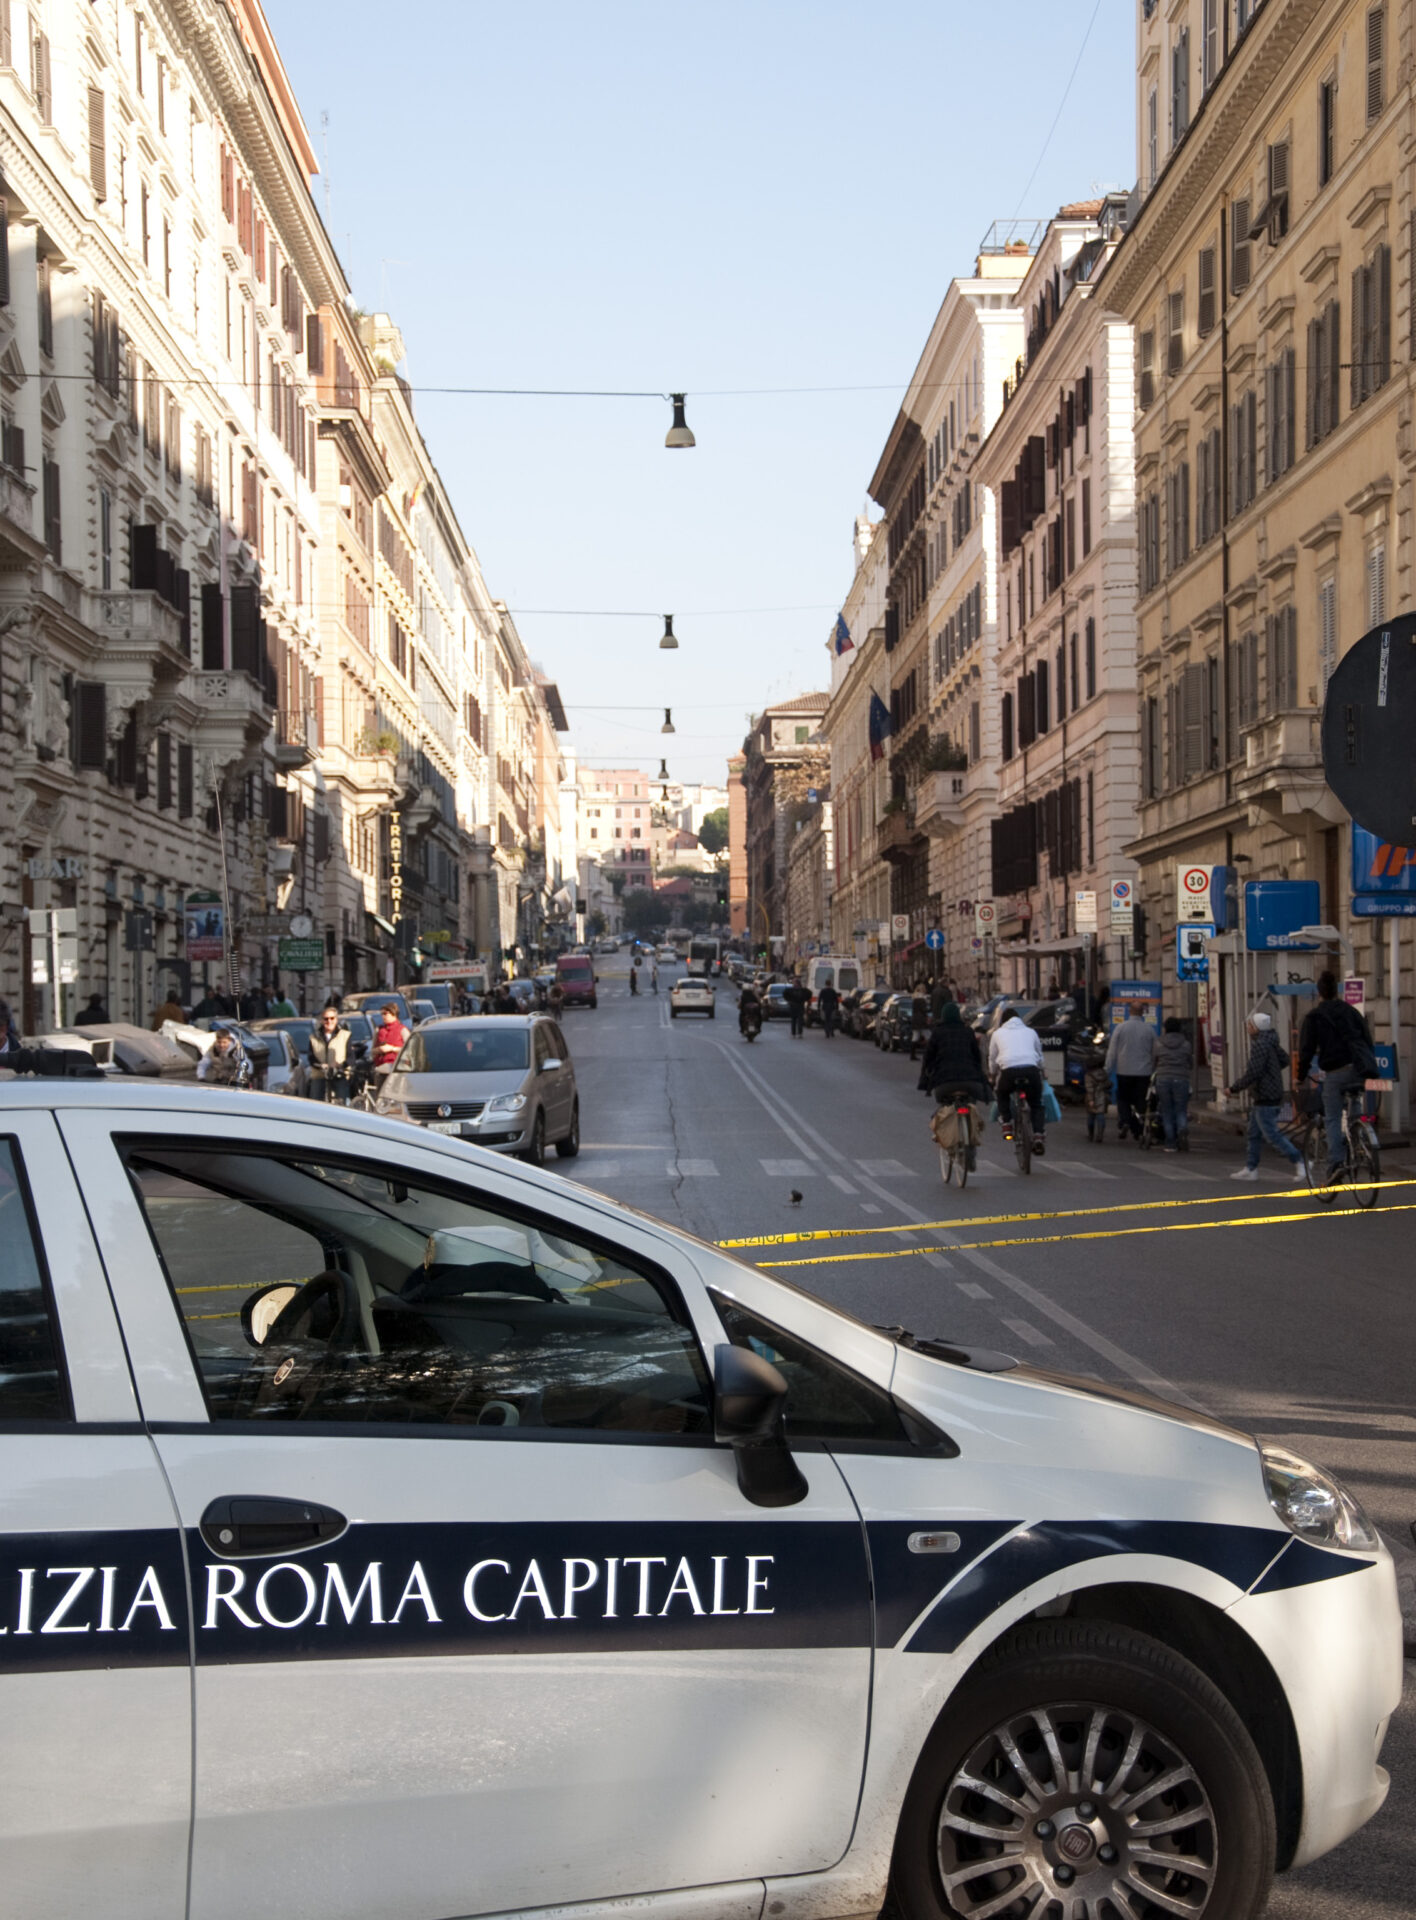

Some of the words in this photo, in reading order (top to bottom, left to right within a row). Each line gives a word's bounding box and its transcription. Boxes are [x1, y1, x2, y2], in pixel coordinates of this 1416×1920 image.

[29, 857, 81, 880] BAR
[1189, 876, 1204, 887] 30
[1368, 904, 1402, 913] GRUPPO
[432, 967, 480, 976] AMBULANZA
[0, 1565, 177, 1635] IZIA
[201, 1561, 443, 1629] ROMA
[463, 1555, 776, 1622] CAPITALE
